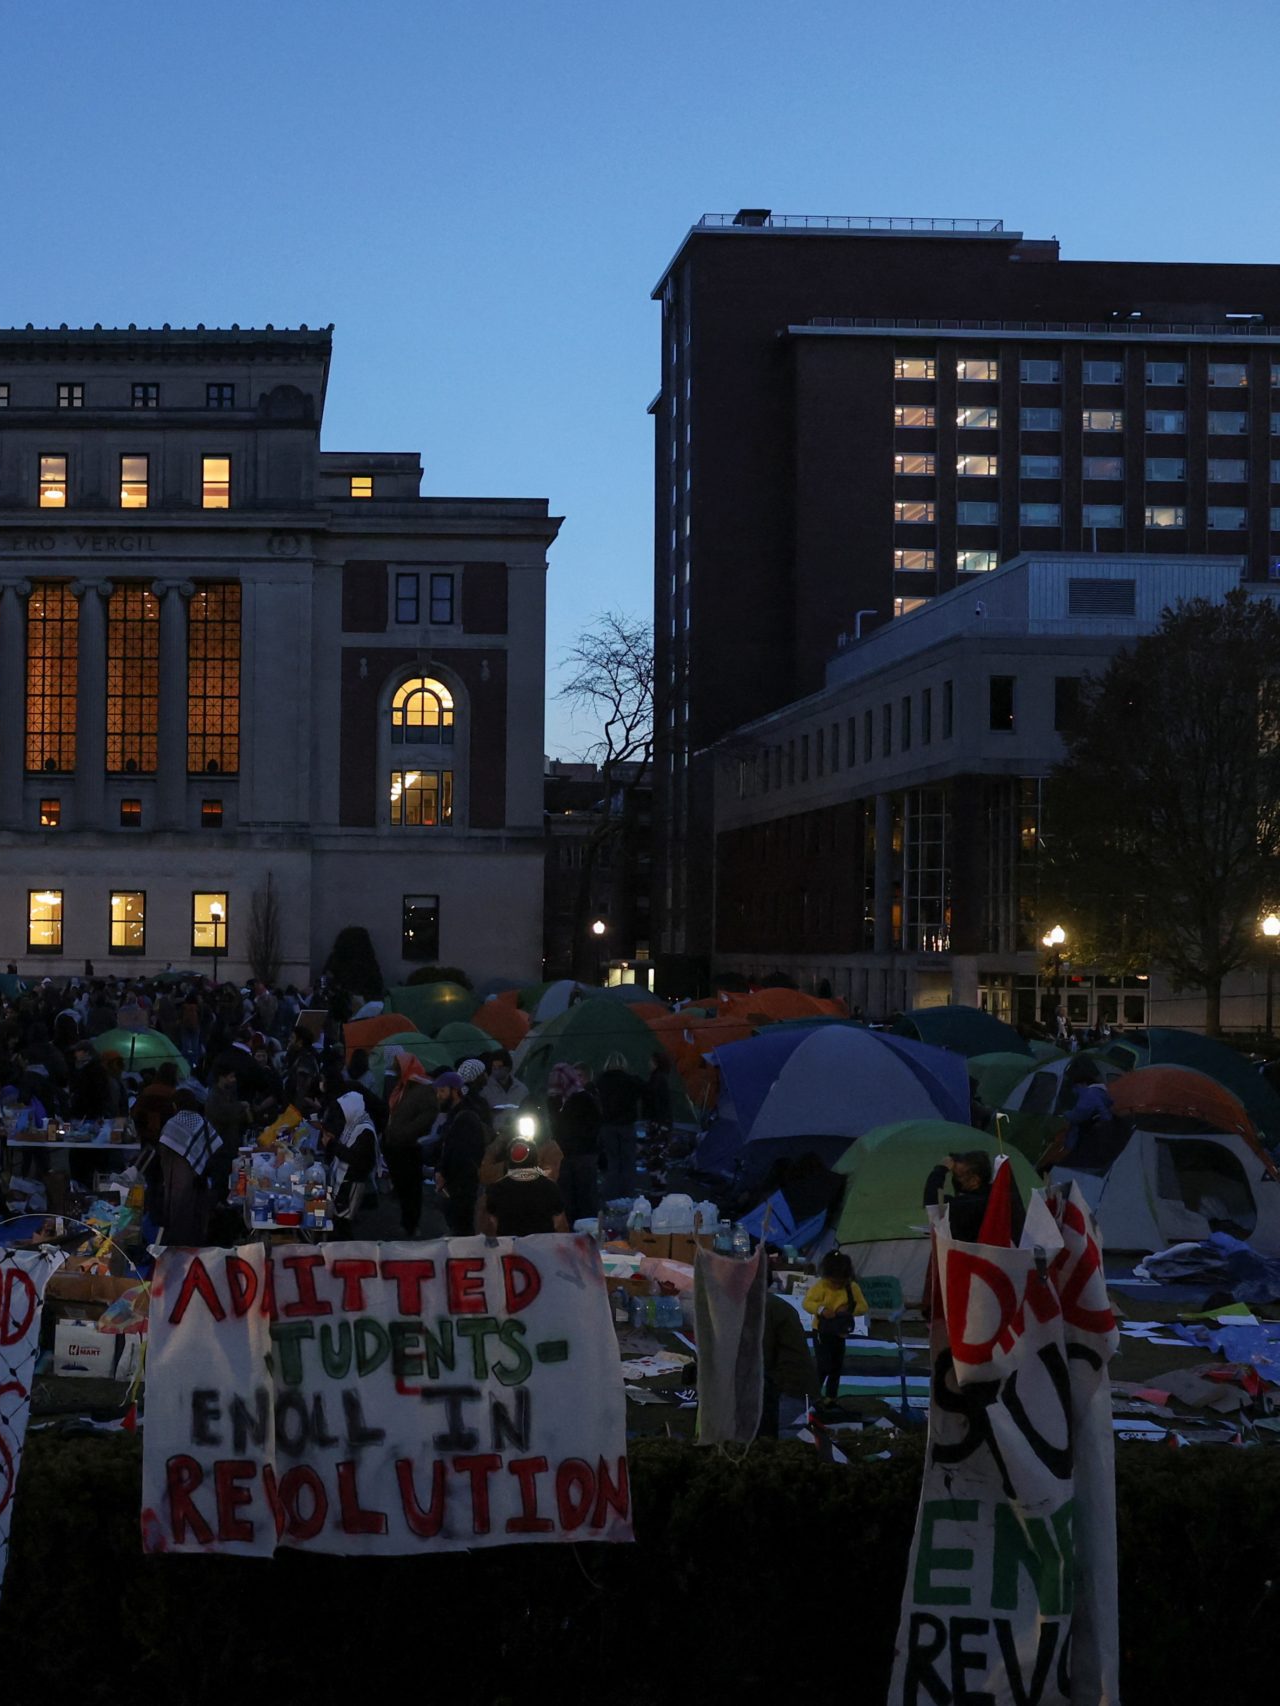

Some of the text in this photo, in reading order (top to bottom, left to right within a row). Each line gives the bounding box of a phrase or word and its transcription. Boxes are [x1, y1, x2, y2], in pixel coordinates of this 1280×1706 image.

[74, 535, 160, 553] VERGIL
[263, 1315, 570, 1387] TUDENTS-
[189, 1385, 532, 1458] ENOLL IN
